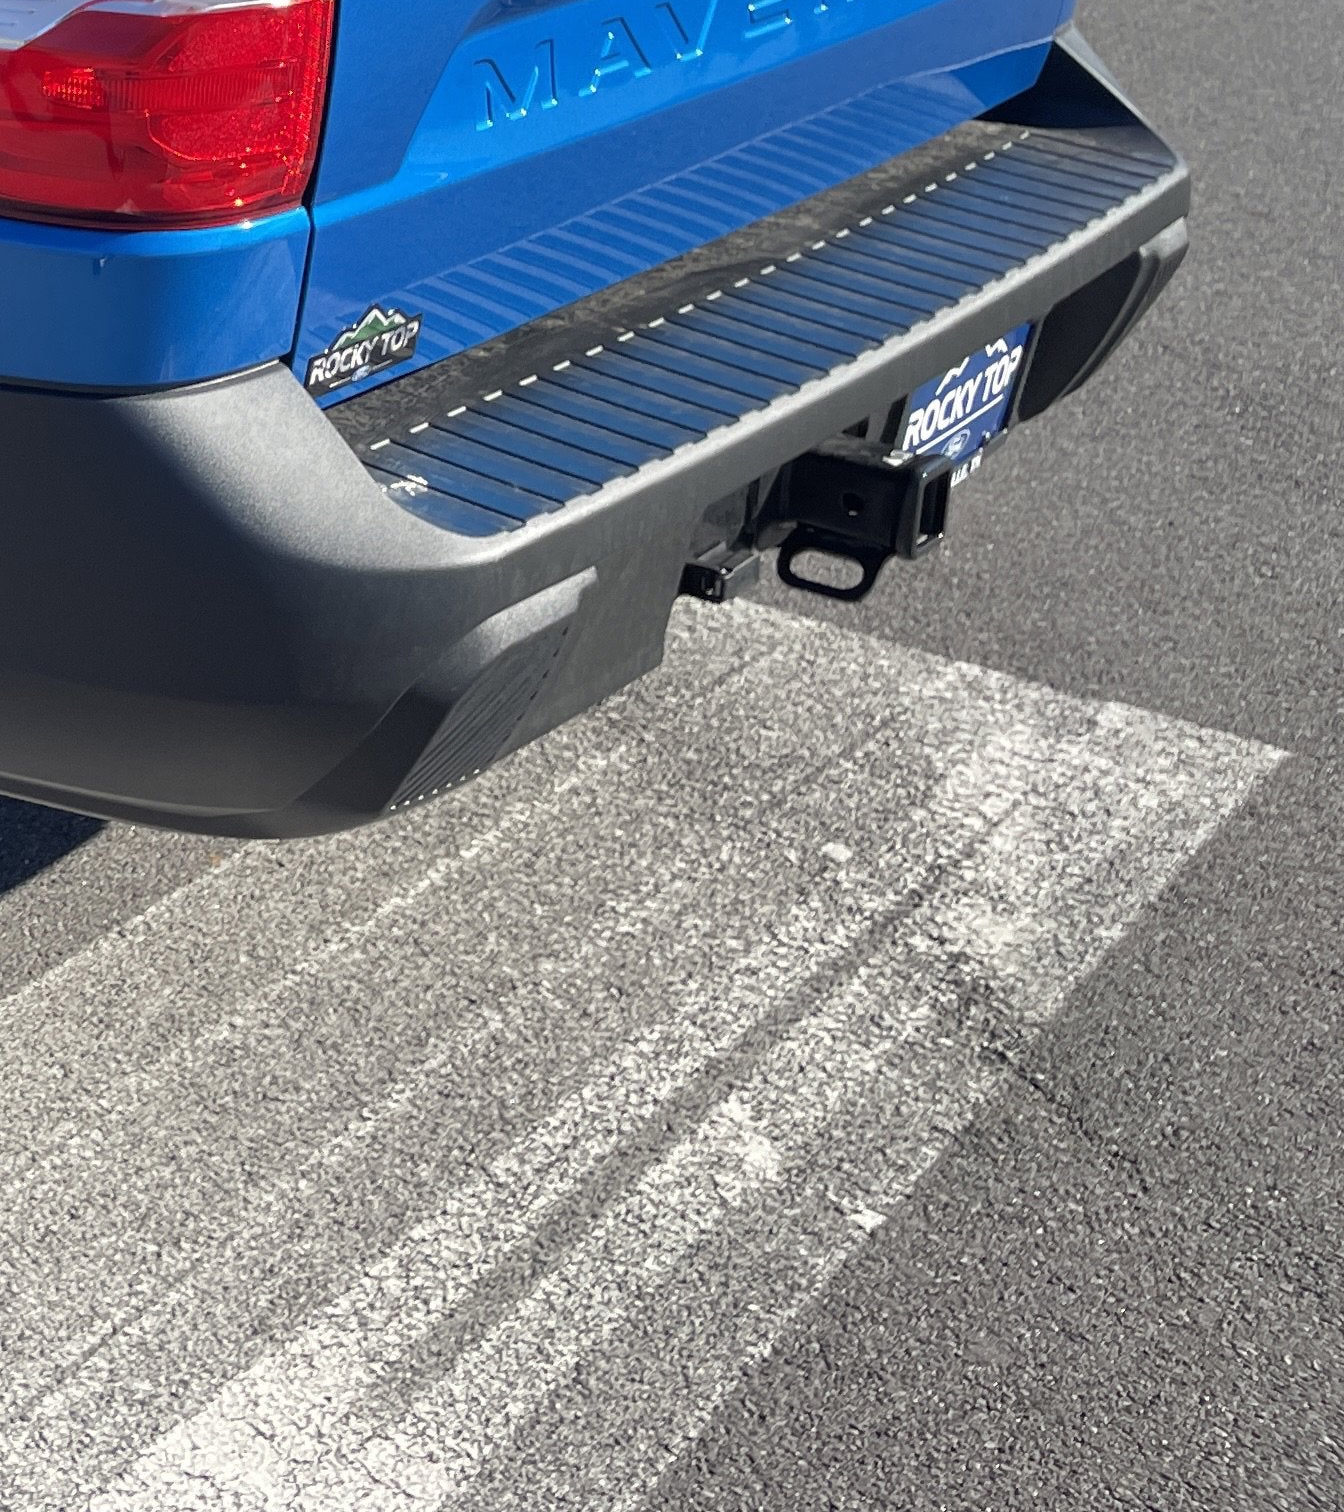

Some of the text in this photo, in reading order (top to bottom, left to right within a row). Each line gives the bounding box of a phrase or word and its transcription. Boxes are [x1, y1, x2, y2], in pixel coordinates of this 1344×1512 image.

[309, 335, 379, 386] ROCKY
[381, 320, 419, 356] TOP
[902, 372, 982, 452] ROCKY
[982, 345, 1023, 402] TOP
